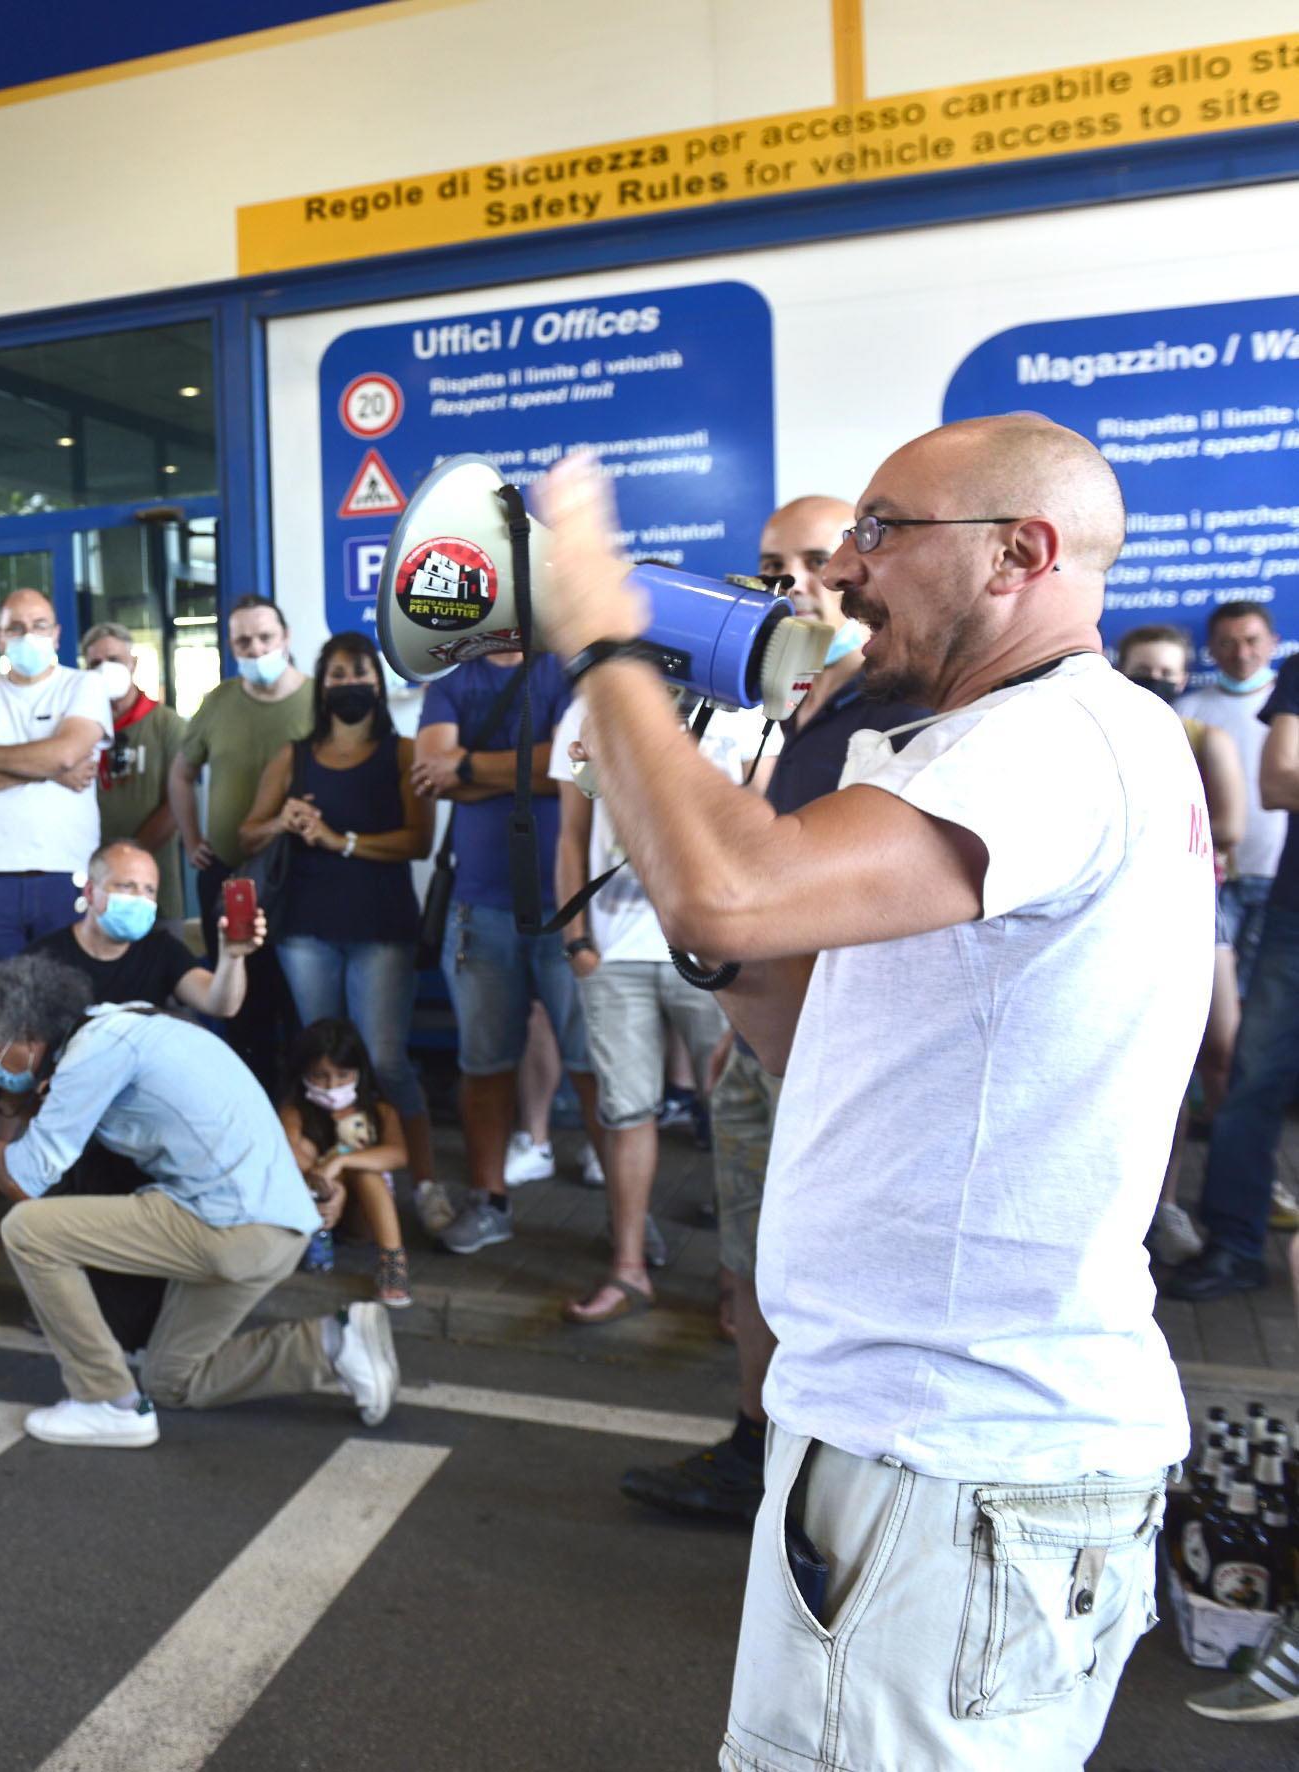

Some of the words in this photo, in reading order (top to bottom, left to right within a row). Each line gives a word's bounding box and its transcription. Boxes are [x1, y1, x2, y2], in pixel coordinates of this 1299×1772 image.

[304, 183, 423, 223] Regole
[438, 171, 470, 201] di
[484, 142, 670, 194] Sicurezza
[685, 129, 746, 166] per
[761, 101, 926, 151] accesso
[942, 65, 1132, 120] carrabile
[1150, 54, 1231, 89] allo
[484, 189, 602, 228] Safety
[618, 170, 729, 206] Rules
[743, 157, 797, 189] for
[811, 133, 956, 178] vehicle
[972, 111, 1122, 155] access
[1139, 101, 1181, 131] to
[1200, 87, 1281, 121] site
[413, 317, 502, 359] Uffici
[532, 306, 661, 345] Offices
[429, 372, 505, 396] Rispetta
[509, 368, 521, 386] il
[525, 363, 579, 385] limite
[581, 357, 601, 378] di
[604, 349, 684, 375] velocità
[1016, 340, 1218, 386] Magazzino
[358, 393, 386, 418] 20
[509, 386, 568, 410] speed
[570, 380, 615, 401] limit
[409, 604, 430, 614] PER
